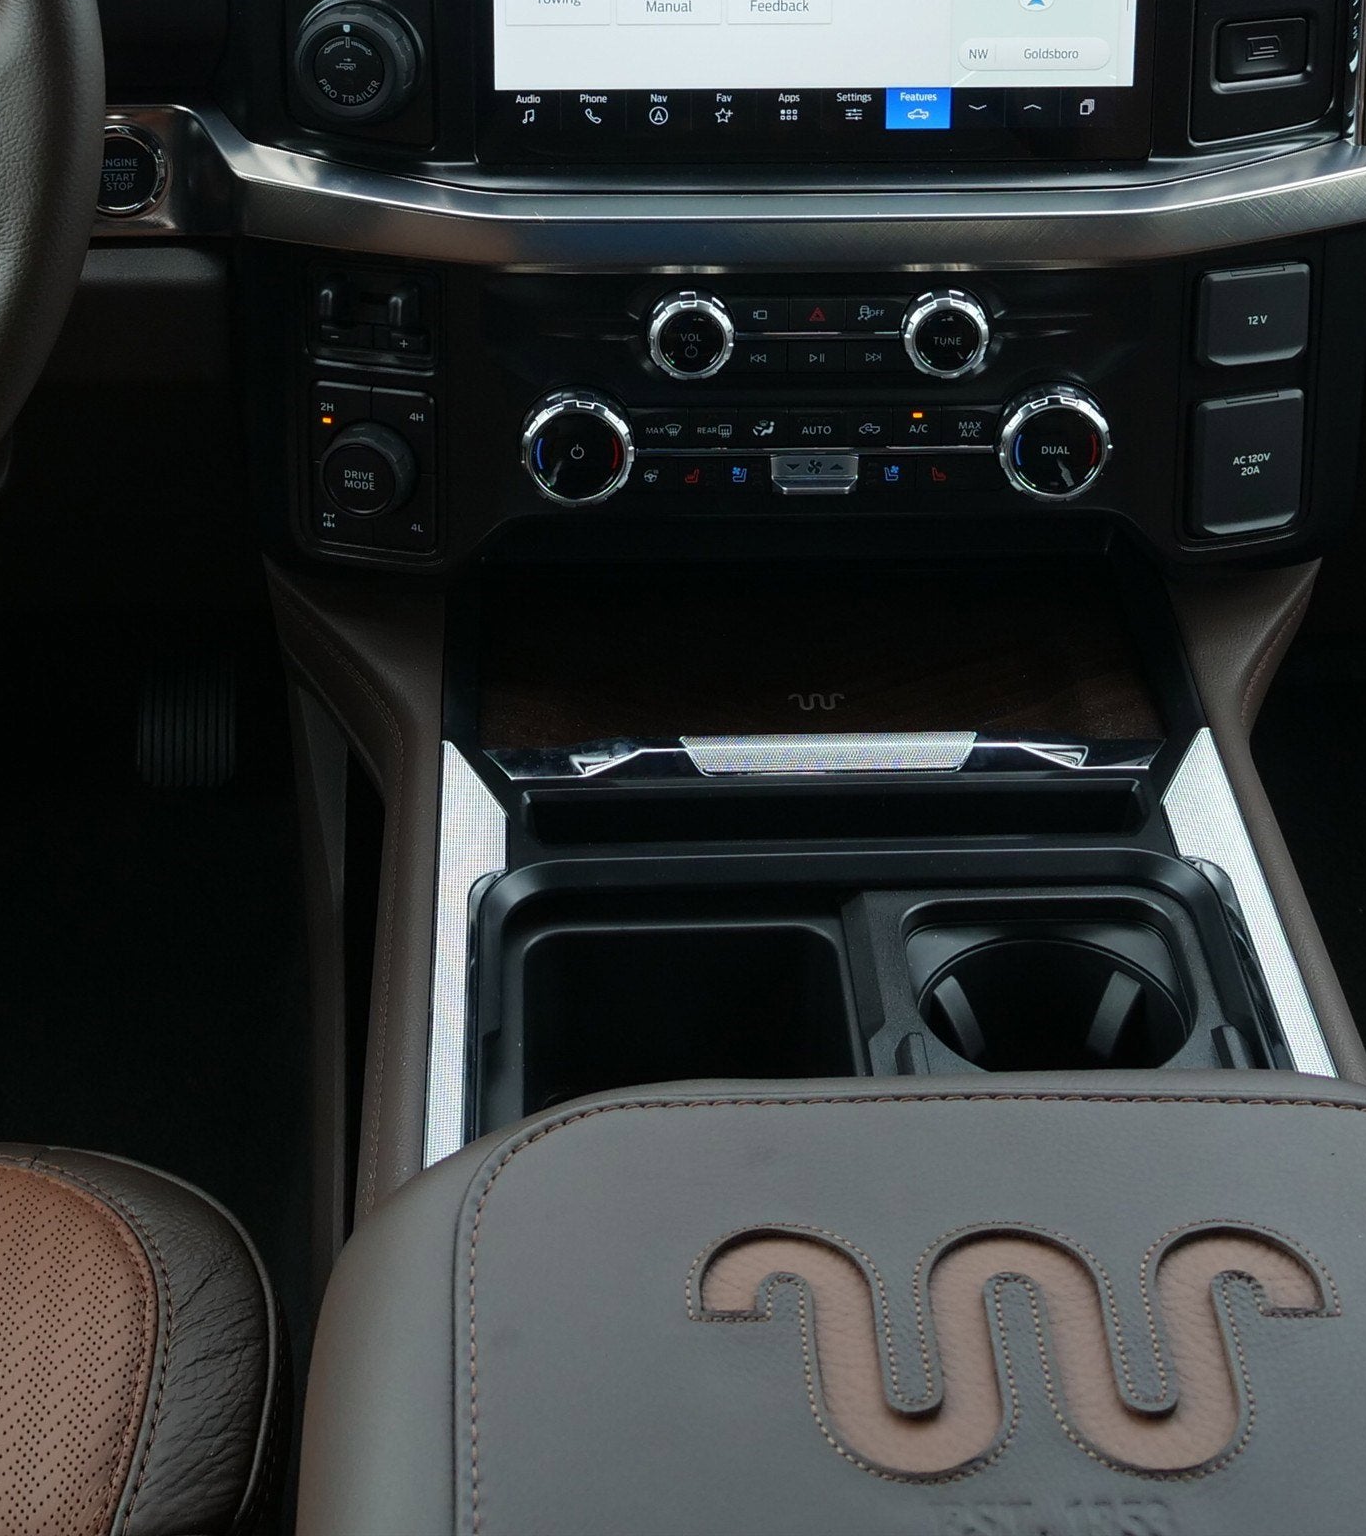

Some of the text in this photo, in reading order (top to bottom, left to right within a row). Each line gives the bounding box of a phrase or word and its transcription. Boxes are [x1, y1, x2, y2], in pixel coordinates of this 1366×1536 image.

[645, 0, 693, 13] Manual
[968, 48, 989, 60] NW
[1023, 48, 1079, 60] Goldsboro
[319, 78, 381, 104] PRO TRAILER
[515, 94, 541, 104] Audio
[579, 93, 607, 104] Phone
[650, 93, 668, 104] Nav
[716, 92, 733, 103] Fav
[777, 92, 801, 105] Apps
[836, 92, 872, 104] Settings
[900, 92, 937, 102] Features
[103, 172, 135, 182] START
[105, 182, 135, 192] STOP
[1247, 314, 1268, 326] 12 V
[680, 333, 702, 342] VOL
[933, 336, 963, 346] TUNE
[320, 402, 334, 412] 2H
[409, 412, 425, 422] 4H
[697, 426, 717, 434] REAR
[801, 424, 832, 435] AUTO
[909, 423, 929, 434] A/C
[958, 420, 981, 430] MAX
[960, 428, 981, 438] A/C
[1041, 445, 1071, 456] DUAL
[1232, 452, 1271, 466] AC 120V
[344, 470, 375, 481] DRIVE
[1241, 466, 1261, 476] 20A
[344, 480, 375, 491] MODE
[411, 523, 424, 533] 4L
